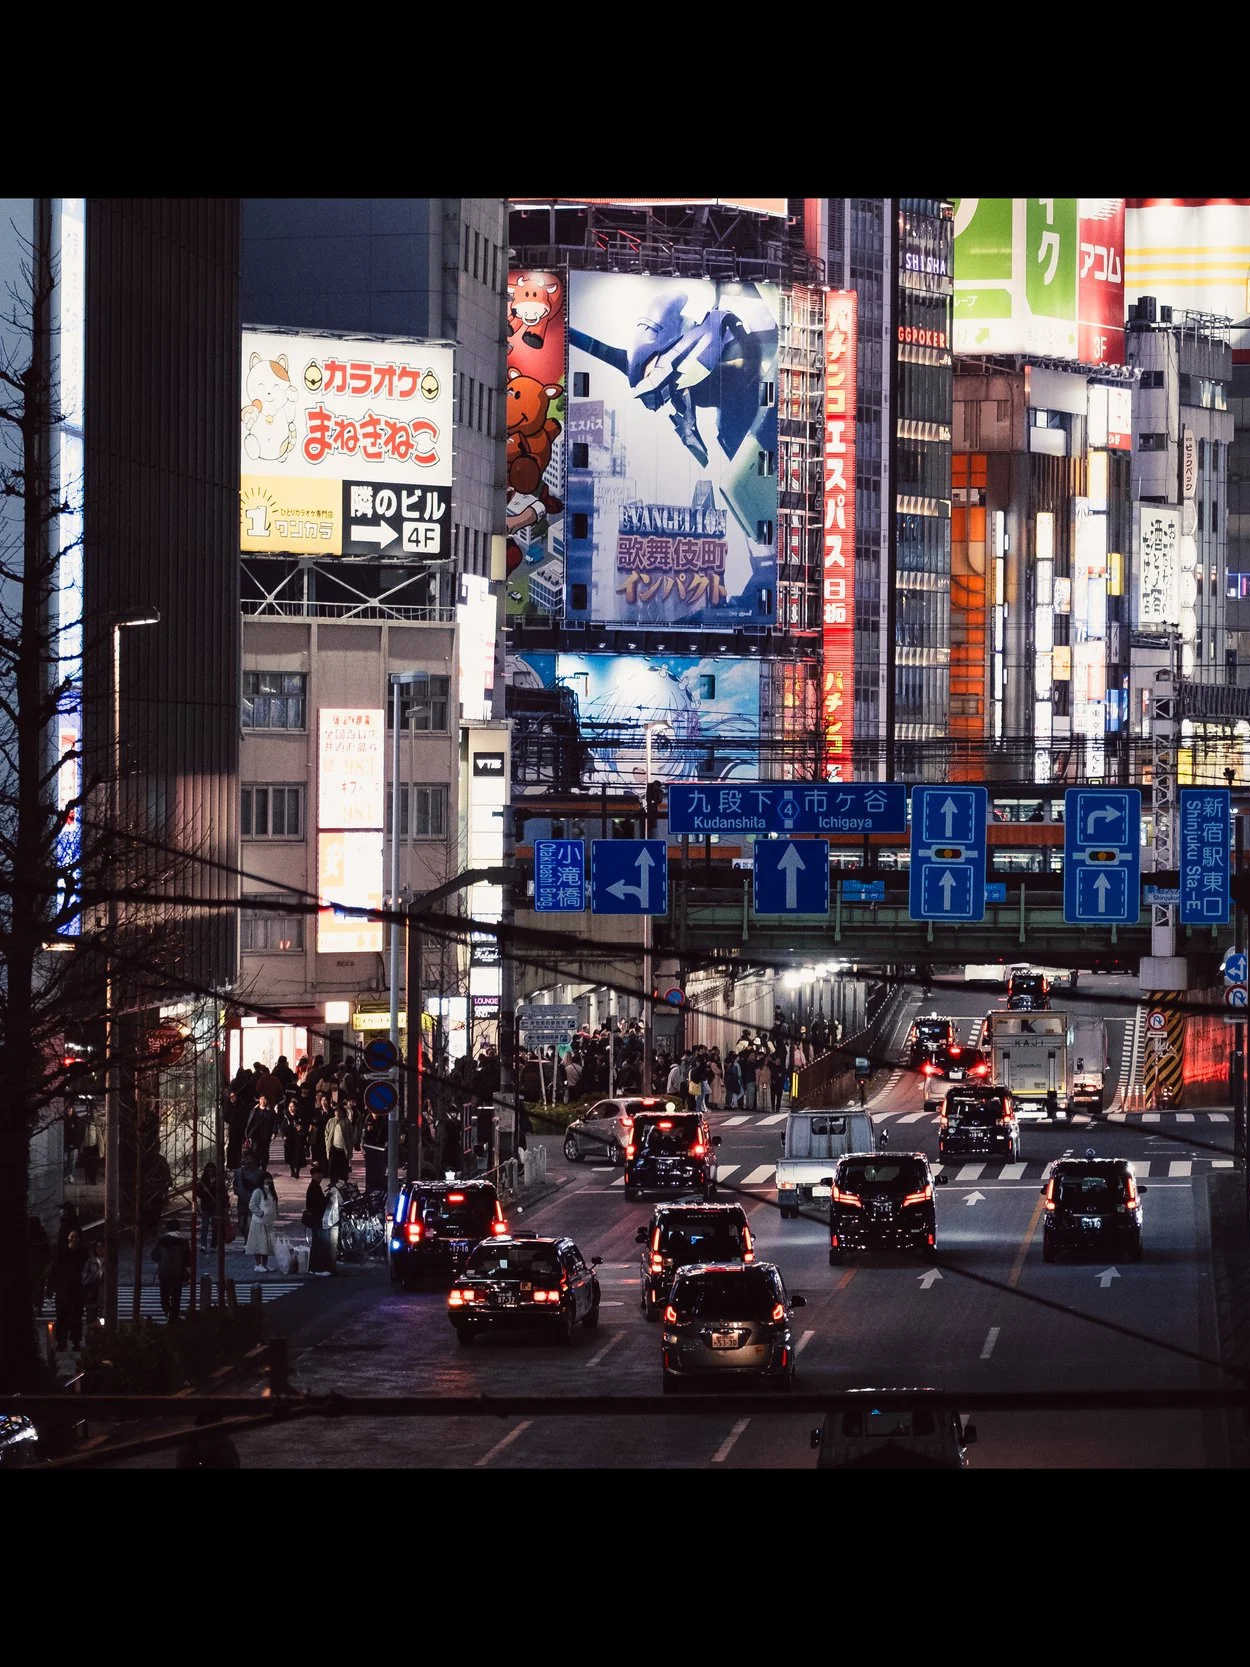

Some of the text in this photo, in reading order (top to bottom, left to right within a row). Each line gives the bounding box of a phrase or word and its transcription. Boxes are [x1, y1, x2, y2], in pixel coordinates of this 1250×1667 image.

[905, 252, 946, 275] SHISHA
[1080, 242, 1122, 284] アコム
[898, 326, 946, 348] GGPOKER
[323, 360, 421, 398] カラオケ
[303, 404, 439, 463] まねきねこ
[350, 485, 446, 521] 隣のビル
[275, 519, 334, 540] ワンカラ
[619, 505, 728, 535] EVANGELION
[407, 527, 436, 548] 4F
[617, 536, 728, 572] 歌舞伎町
[616, 570, 728, 605] インパクト
[688, 788, 773, 814] 九段下
[784, 803, 793, 816] 4
[694, 816, 766, 830] Kudanshita
[819, 815, 873, 829] Ichigaya
[1184, 800, 1202, 860] Shinjuku
[1202, 797, 1224, 916] 新宿駅東口
[556, 844, 581, 909] 小滝橋
[1014, 1039, 1045, 1047] KAJI
[717, 1339, 738, 1347] 53-30
